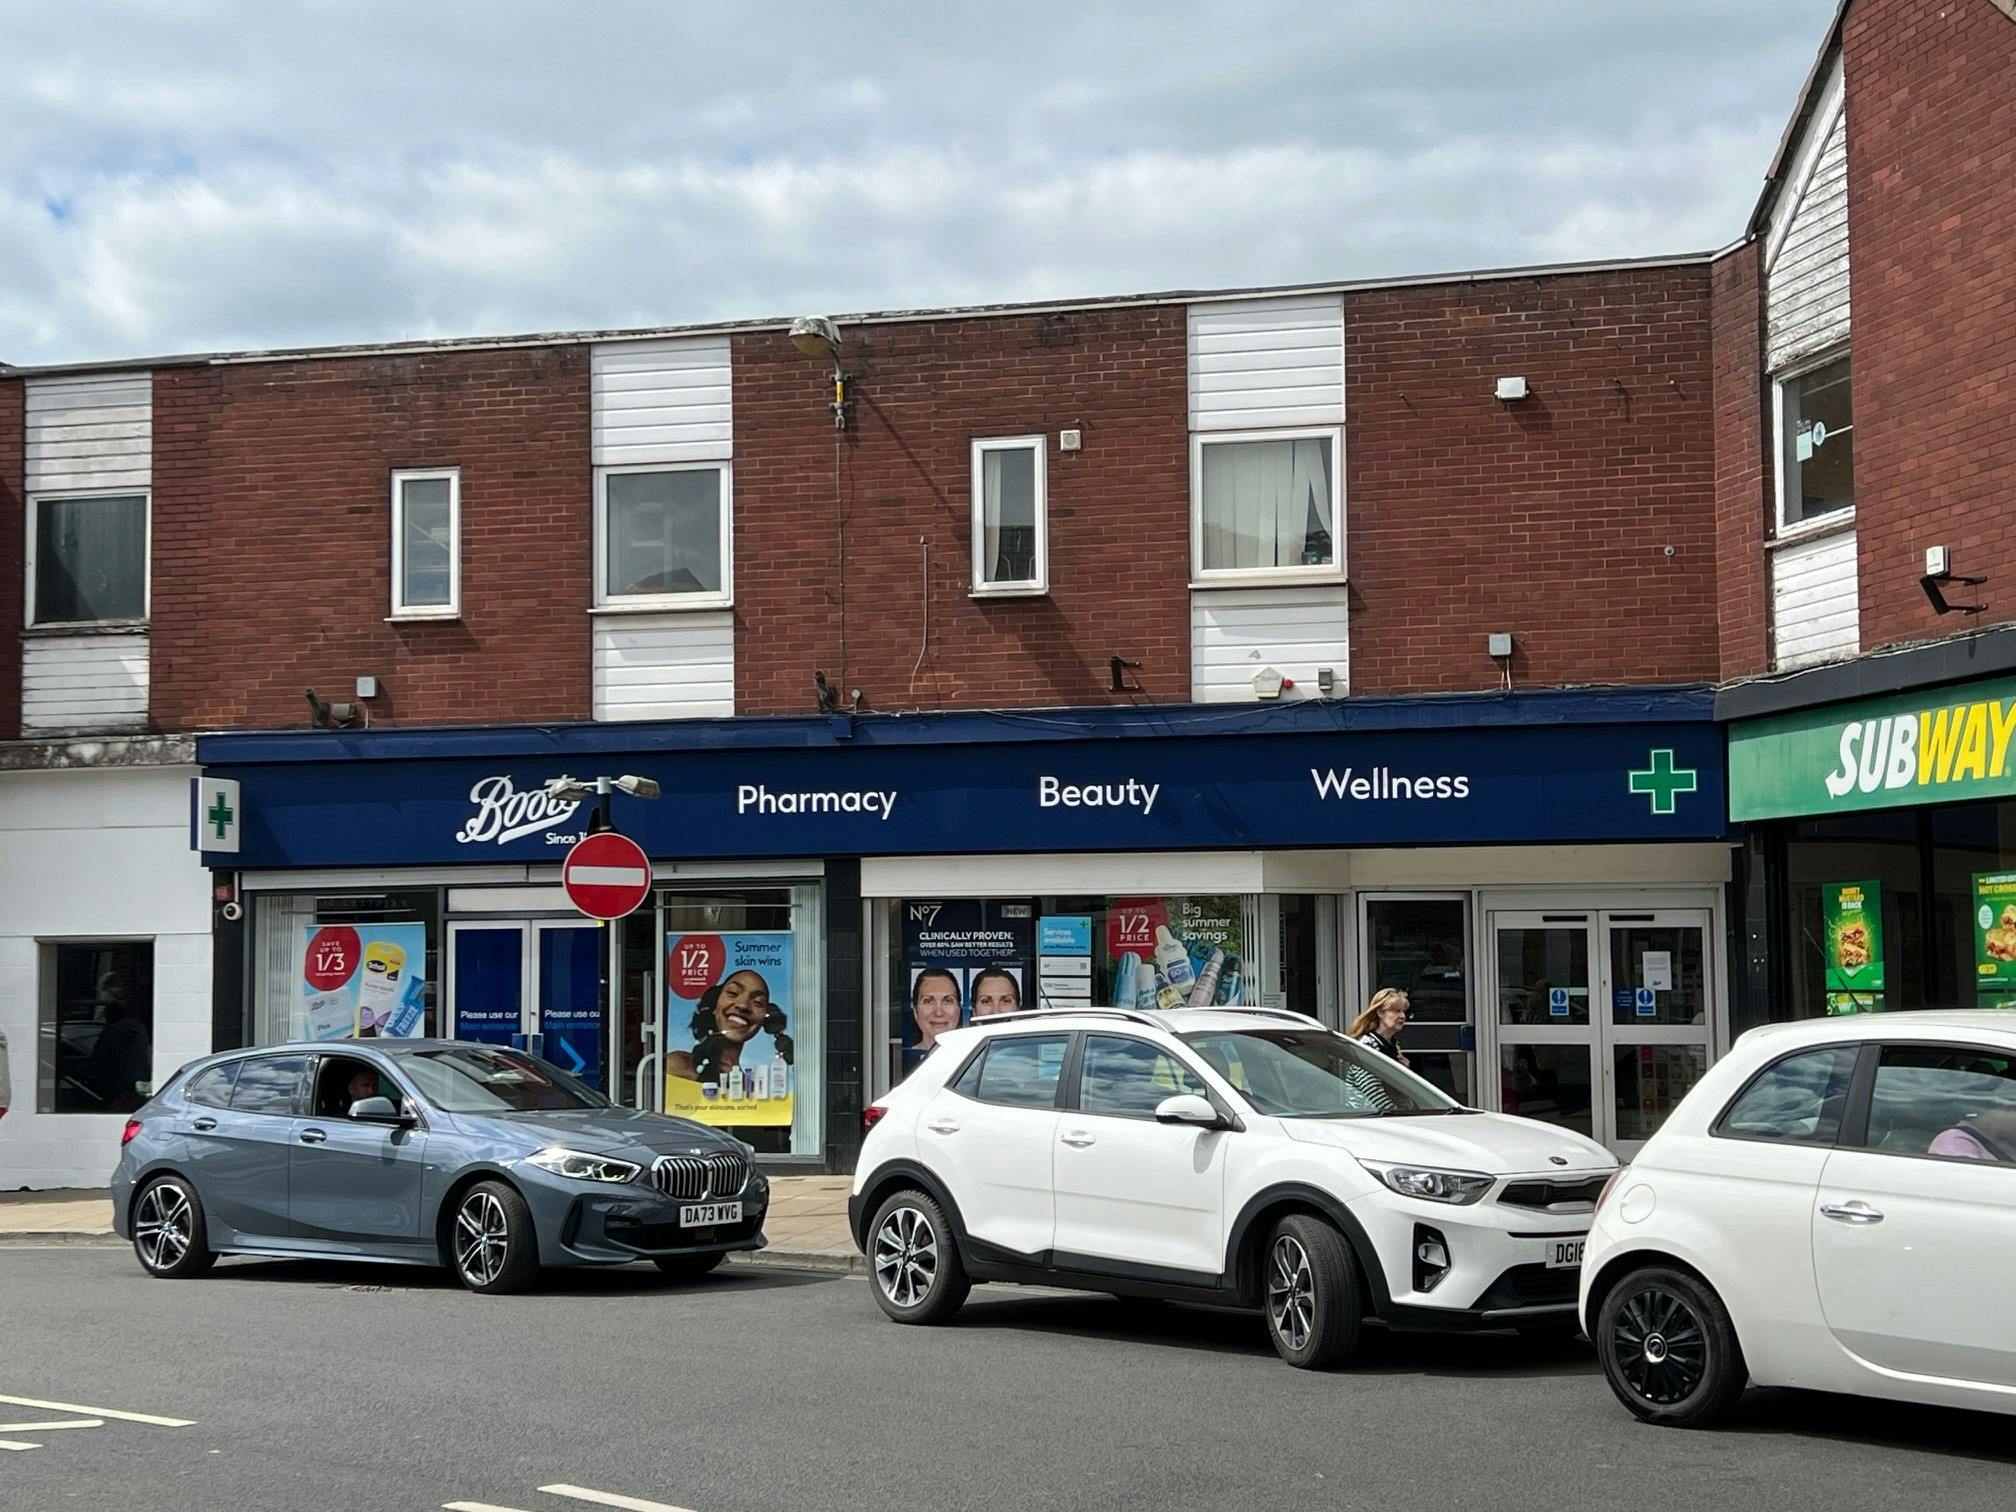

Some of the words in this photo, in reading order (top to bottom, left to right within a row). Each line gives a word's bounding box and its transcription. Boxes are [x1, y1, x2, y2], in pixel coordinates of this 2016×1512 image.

[1825, 701, 2016, 799] SUBWAY
[1311, 767, 1470, 800] Wellness
[738, 785, 897, 820] Pharmacy
[1039, 776, 1160, 815] Beauty
[545, 832, 576, 845] Since
[1006, 907, 1027, 915] NEW
[1182, 902, 1201, 918] Big
[1119, 915, 1150, 933] 1/2
[1182, 918, 1231, 928] summer
[919, 931, 972, 940] CLINICALLY
[1182, 929, 1228, 943] savings
[735, 941, 782, 953] Summer
[920, 949, 945, 957] WHEN
[945, 949, 967, 957] USED
[316, 953, 345, 972] 1/3
[681, 950, 709, 968] 1/2
[735, 955, 756, 967] skin
[759, 955, 782, 966] wins
[460, 1010, 487, 1019] Please
[488, 1011, 503, 1019] use
[504, 1011, 519, 1019] our
[544, 1009, 572, 1018] Please
[573, 1010, 588, 1018] use
[685, 1206, 715, 1223] DA73
[717, 1204, 738, 1220] WVG
